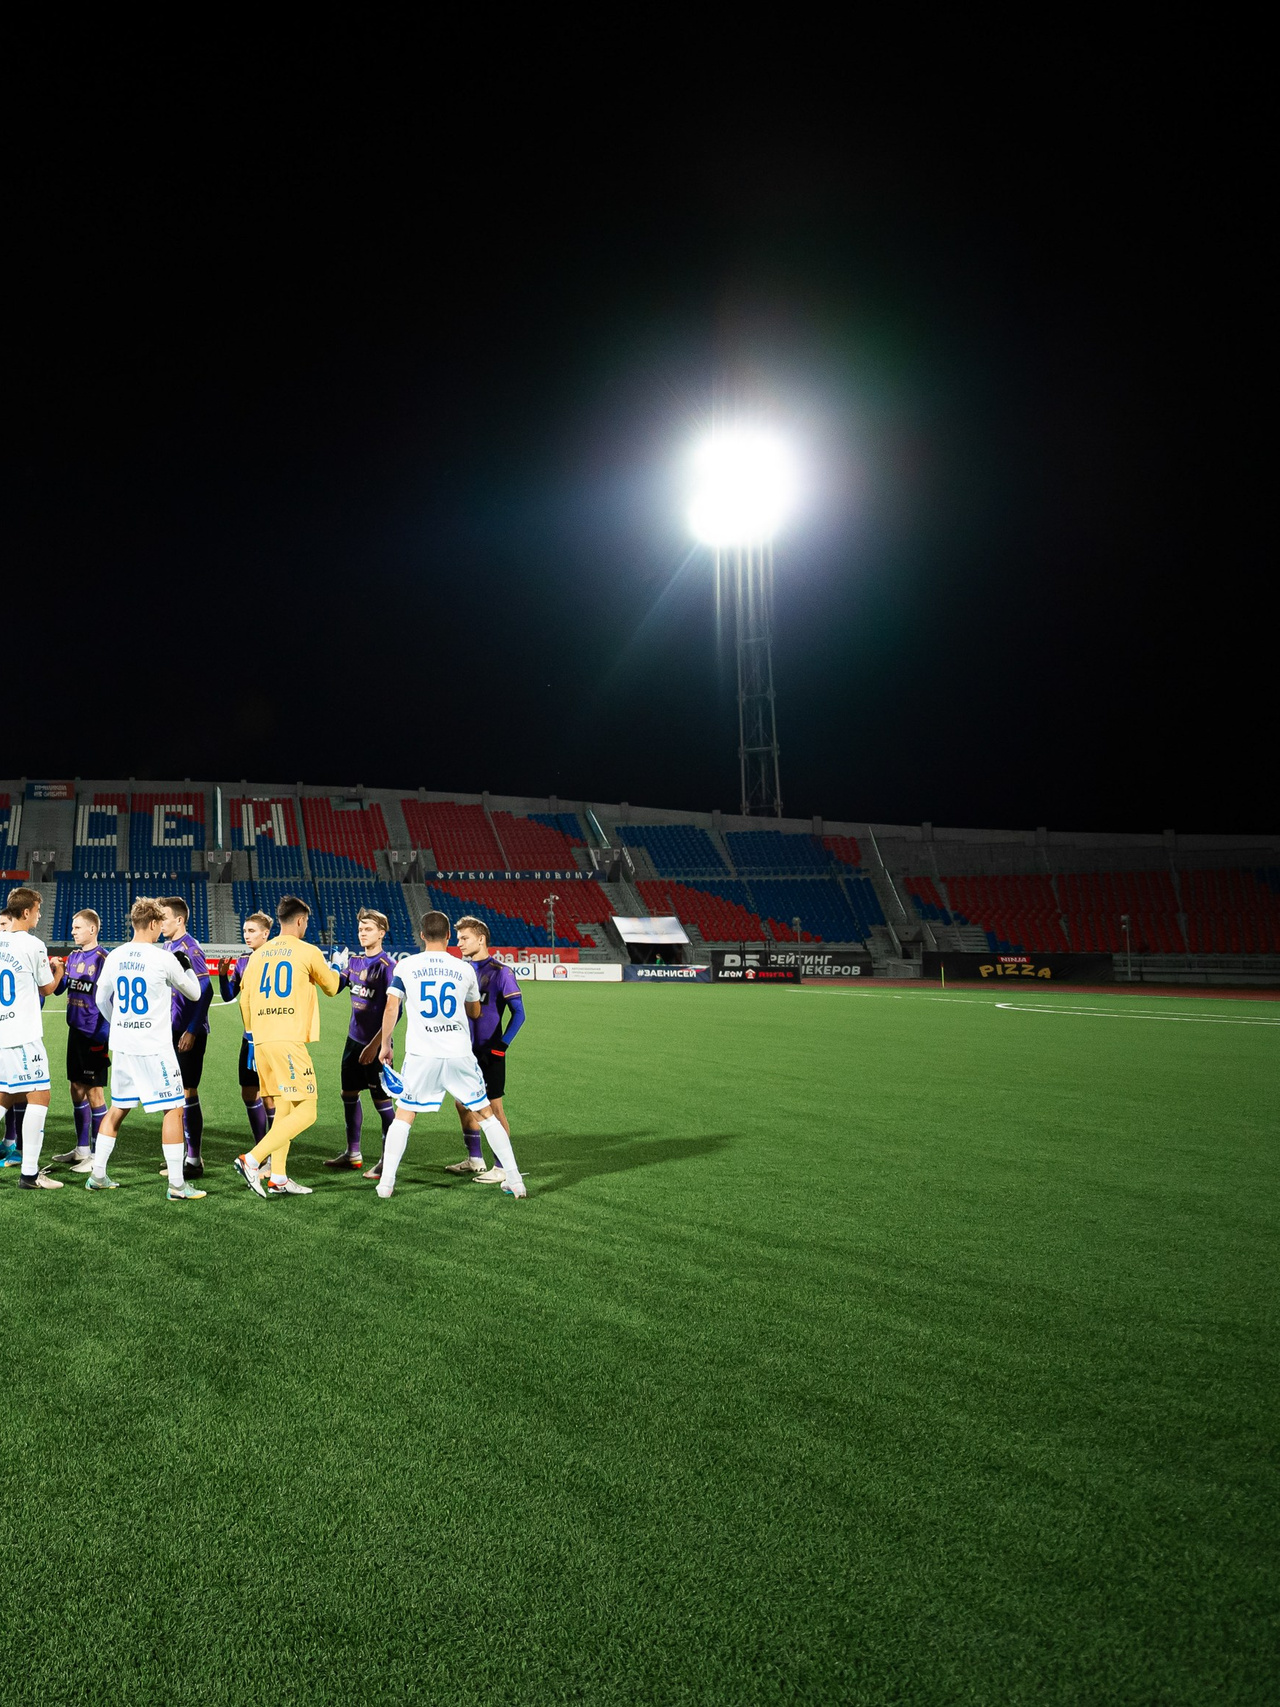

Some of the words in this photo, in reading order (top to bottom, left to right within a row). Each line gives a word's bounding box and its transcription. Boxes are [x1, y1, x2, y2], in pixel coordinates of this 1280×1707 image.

[259, 960, 293, 999] 40
[636, 969, 697, 978] #ЗАЕНИСЕЙ
[978, 964, 1053, 979] PIZZA
[117, 975, 149, 1016] 98
[420, 981, 457, 1019] 56
